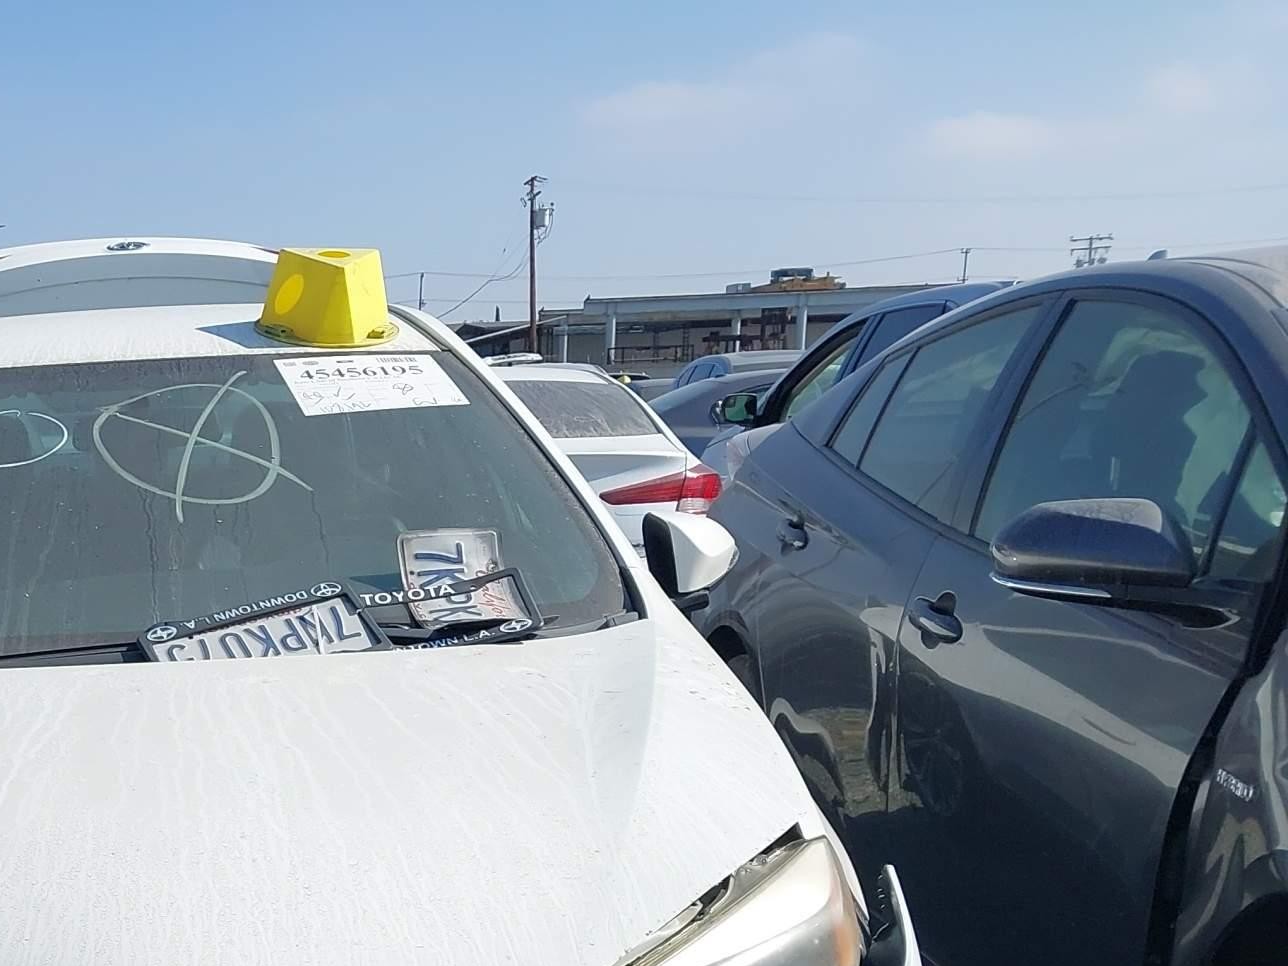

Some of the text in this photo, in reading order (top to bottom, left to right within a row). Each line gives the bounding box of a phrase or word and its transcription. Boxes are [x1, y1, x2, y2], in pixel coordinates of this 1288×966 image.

[299, 365, 424, 380] 45456195
[360, 584, 457, 606] TOYOTA
[213, 590, 308, 622] DOWNTOWN
[180, 618, 211, 629] L.A.
[463, 629, 496, 642] L.A.
